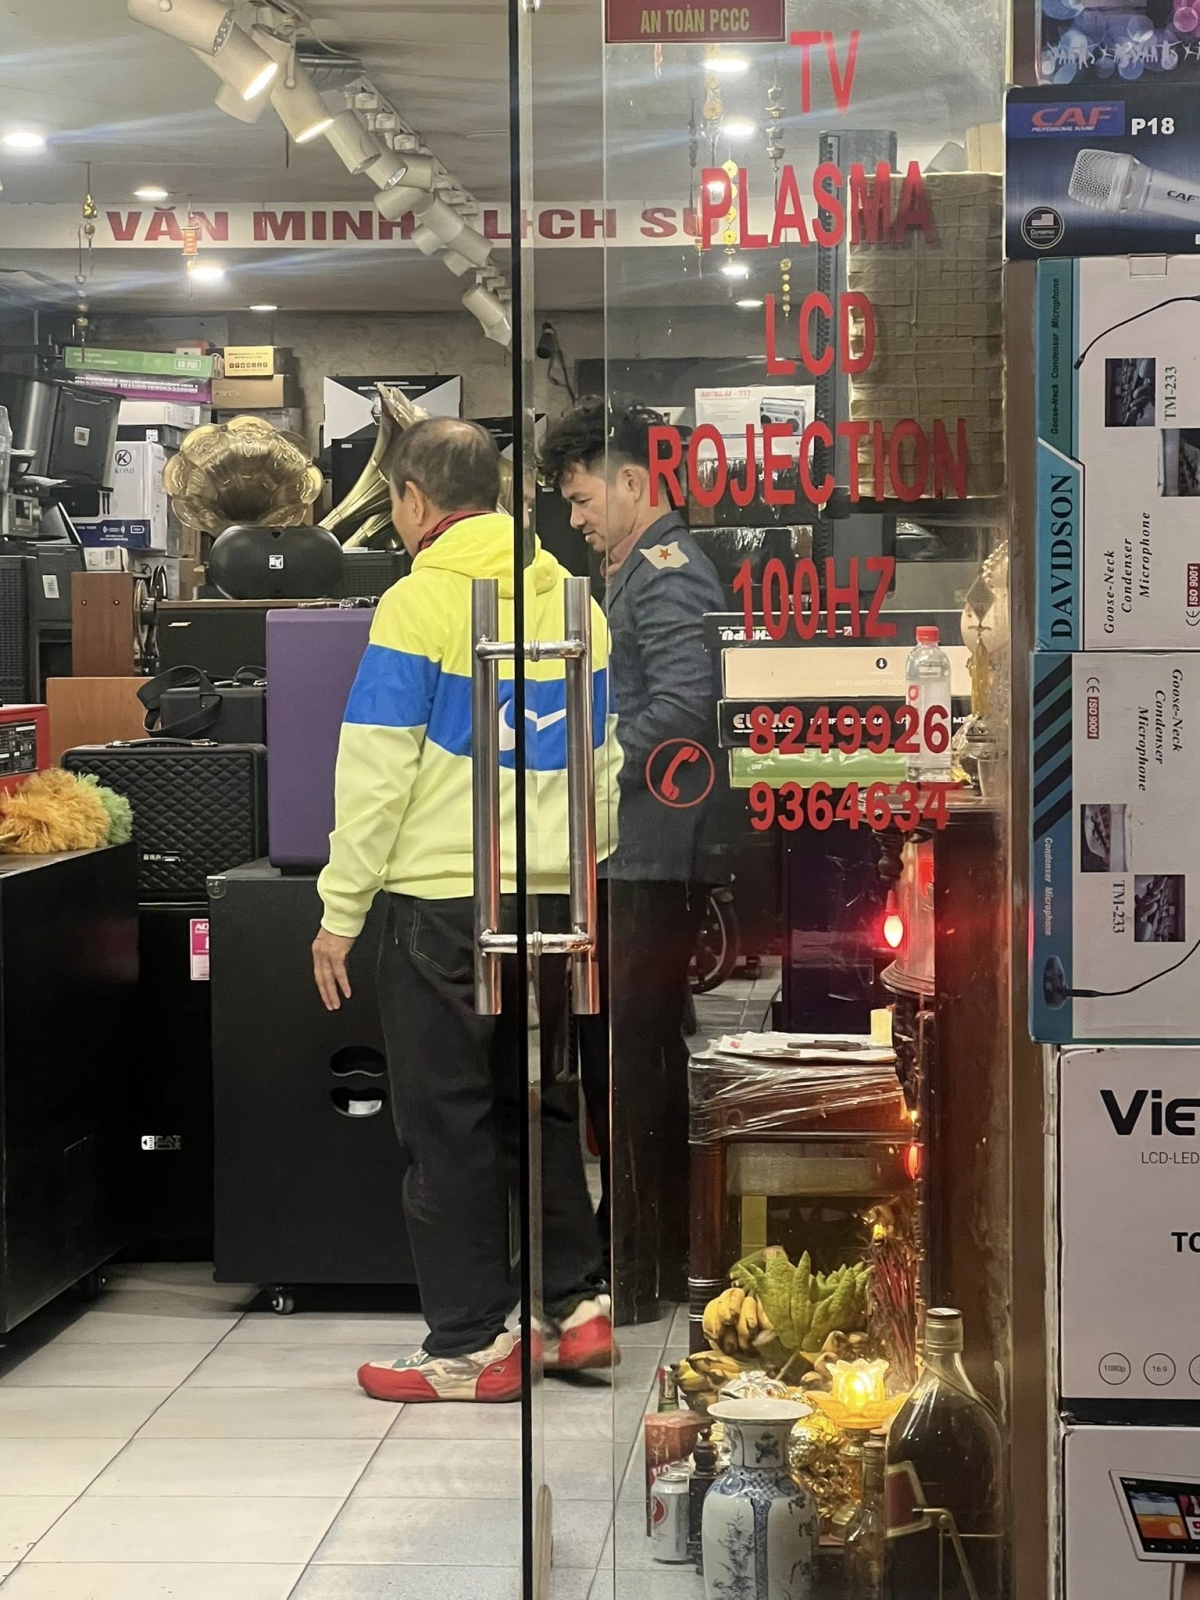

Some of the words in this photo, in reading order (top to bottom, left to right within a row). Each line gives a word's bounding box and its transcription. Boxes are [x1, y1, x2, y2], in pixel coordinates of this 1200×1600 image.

[640, 10, 661, 33] AN
[666, 4, 704, 33] TOÀN
[710, 8, 749, 32] PCCC
[790, 30, 860, 114] TV
[1031, 107, 1113, 127] CAF
[1131, 117, 1175, 136] P18
[700, 160, 935, 250] PLASMA
[1167, 190, 1198, 202] CAF
[106, 206, 229, 241] VĂN
[253, 210, 415, 241] MINH
[1051, 278, 1060, 329] Microphone
[765, 291, 875, 377] LCD
[1051, 333, 1060, 379] Condenser
[1051, 384, 1060, 434] Goose-Neck
[1164, 366, 1177, 421] TM-233
[648, 418, 967, 508] ROJECTION
[1050, 474, 1073, 639] DAVIDSON
[1121, 538, 1133, 613] Condenser
[1139, 512, 1152, 598] Microphone
[1188, 565, 1199, 587] 9001
[733, 556, 897, 641] 100HZ
[1103, 550, 1115, 634] Goose-Neck
[1188, 593, 1199, 606] ISO
[749, 704, 949, 755] 8249926
[1155, 689, 1166, 765] Condenser
[1172, 668, 1184, 752] Goose-Neck
[1135, 706, 1149, 791] Microphone
[749, 781, 949, 831] 9364634
[1044, 837, 1053, 883] Condenser
[1043, 886, 1053, 936] Microphone
[1112, 880, 1125, 934] TM-233
[1141, 1151, 1200, 1164] LCD-LED
[1104, 1364, 1126, 1373] 1080p
